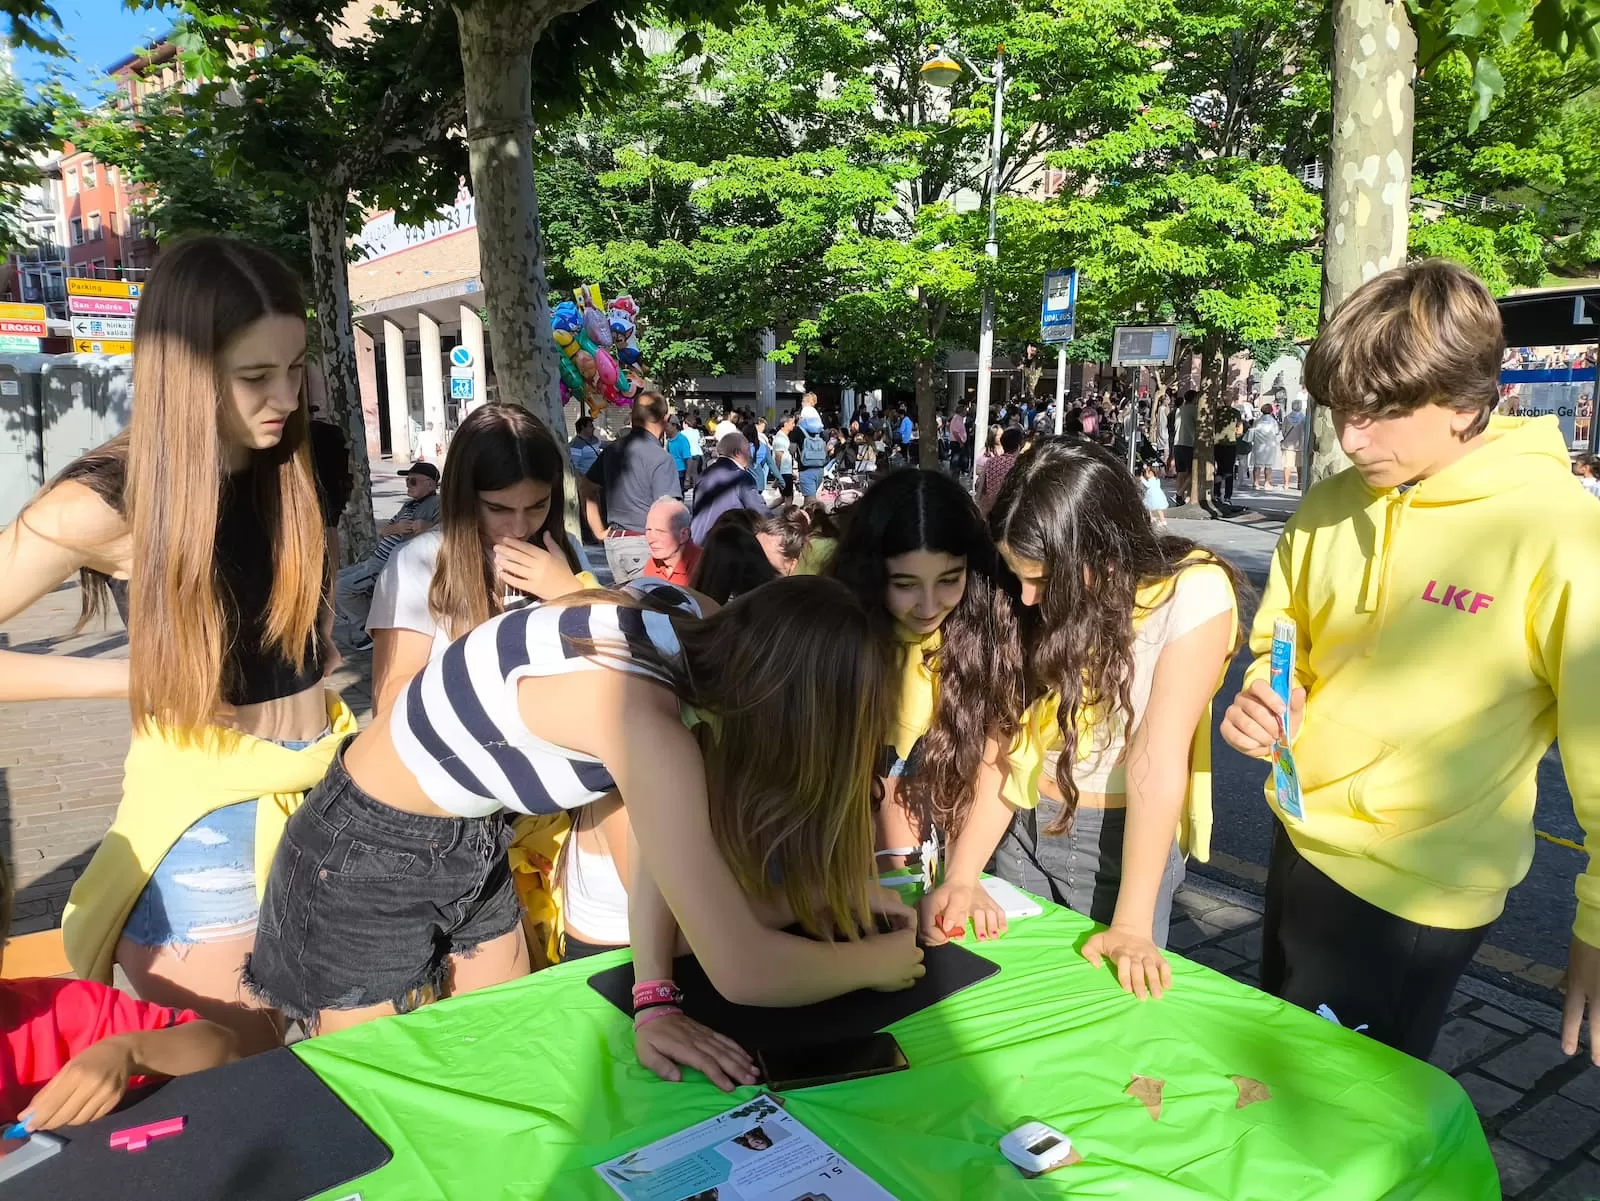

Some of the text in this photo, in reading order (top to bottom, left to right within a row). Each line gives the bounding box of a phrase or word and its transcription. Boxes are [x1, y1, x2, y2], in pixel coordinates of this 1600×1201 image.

[71, 282, 103, 292] Parking
[73, 301, 123, 311] San Andrés
[1, 323, 42, 333] EROSKI
[1508, 406, 1593, 417] Autobus Gelo
[1421, 579, 1495, 614] LKF
